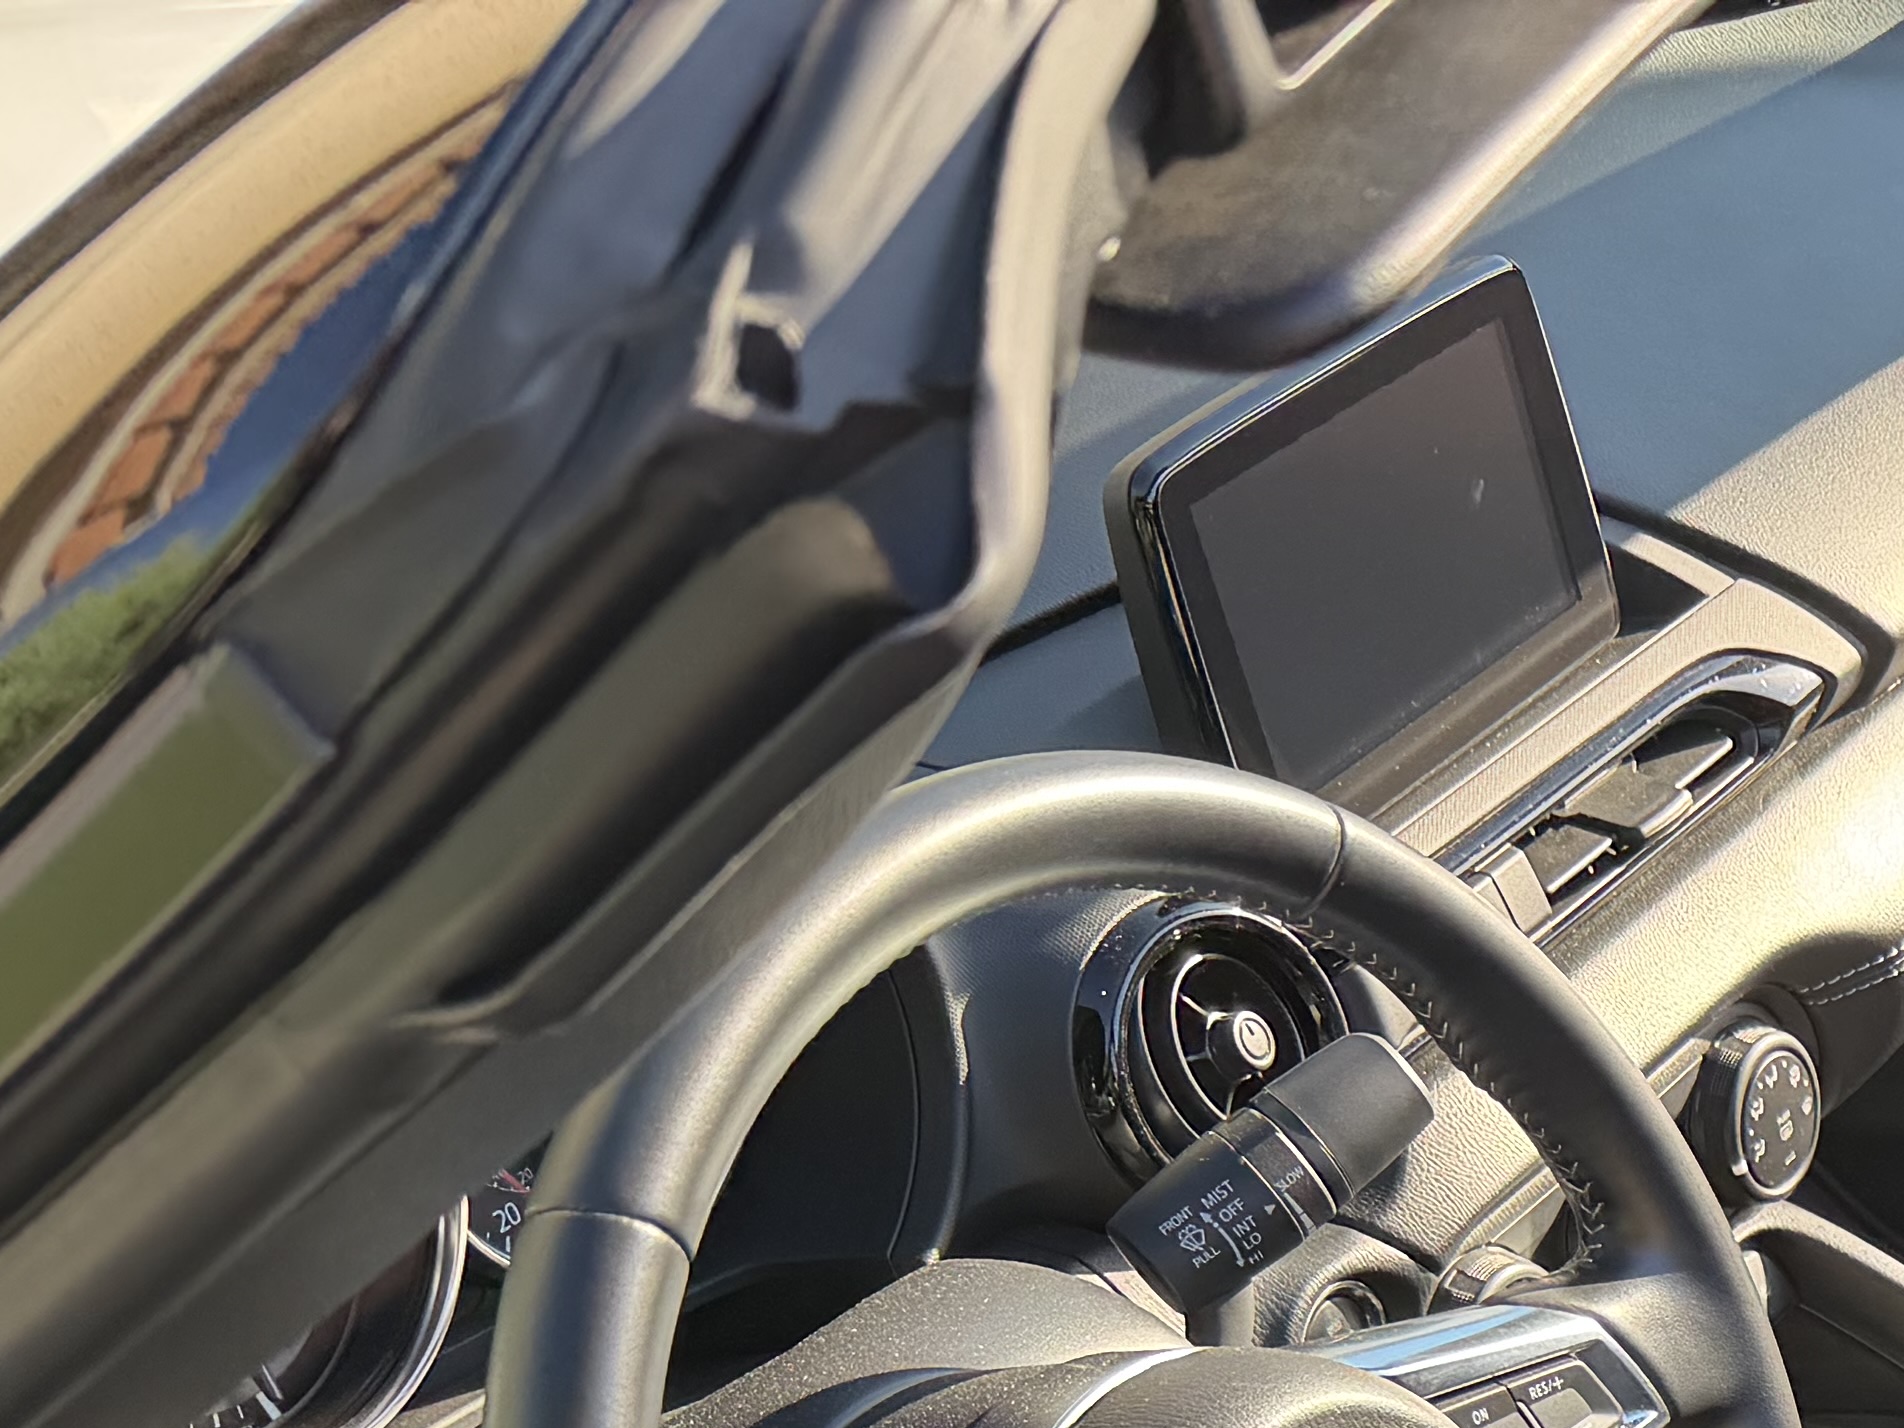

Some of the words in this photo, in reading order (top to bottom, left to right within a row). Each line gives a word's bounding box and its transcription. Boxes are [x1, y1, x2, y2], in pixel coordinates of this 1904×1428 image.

[1273, 1165, 1305, 1193] SLOW
[1200, 1179, 1235, 1210] MIST
[492, 1202, 521, 1234] 20
[1158, 1205, 1194, 1236] FRONT
[1218, 1197, 1245, 1223] OFF
[1232, 1215, 1257, 1239] INT
[1242, 1232, 1262, 1250] LO
[1191, 1246, 1221, 1269] PULL
[1249, 1250, 1264, 1265] HI
[1528, 1376, 1564, 1400] RES/+
[1471, 1407, 1489, 1426] ON
